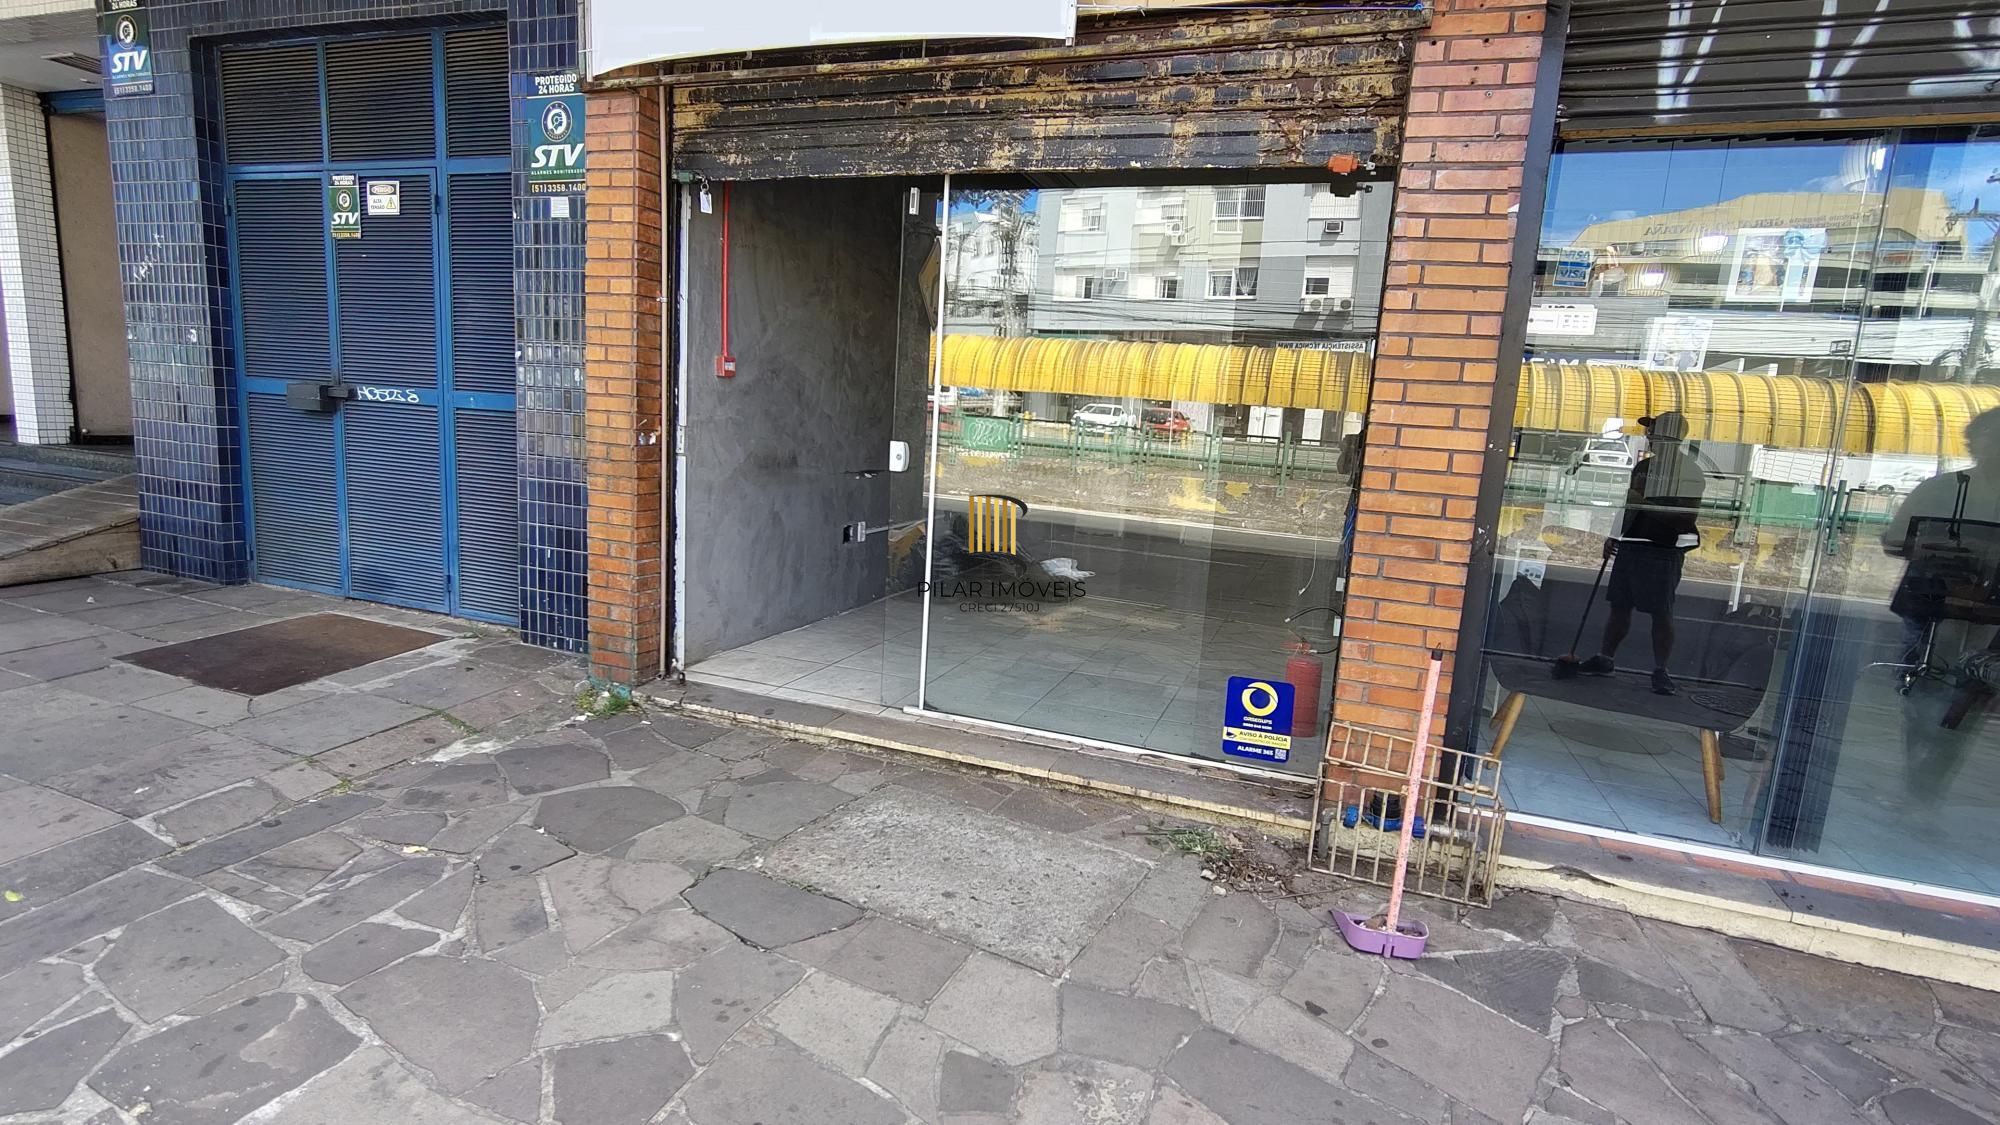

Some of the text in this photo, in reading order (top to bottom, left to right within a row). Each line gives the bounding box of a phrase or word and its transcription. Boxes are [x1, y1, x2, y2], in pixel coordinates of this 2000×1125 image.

[112, 50, 148, 73] STV
[535, 74, 577, 86] PROTEGIDO
[538, 83, 575, 94] 24 HORAS
[531, 143, 585, 168] STV
[331, 212, 359, 225] STV
[1560, 269, 1586, 280] VISA
[1264, 734, 1288, 742] POLÍCIA
[1237, 745, 1274, 756] ALARME 365
